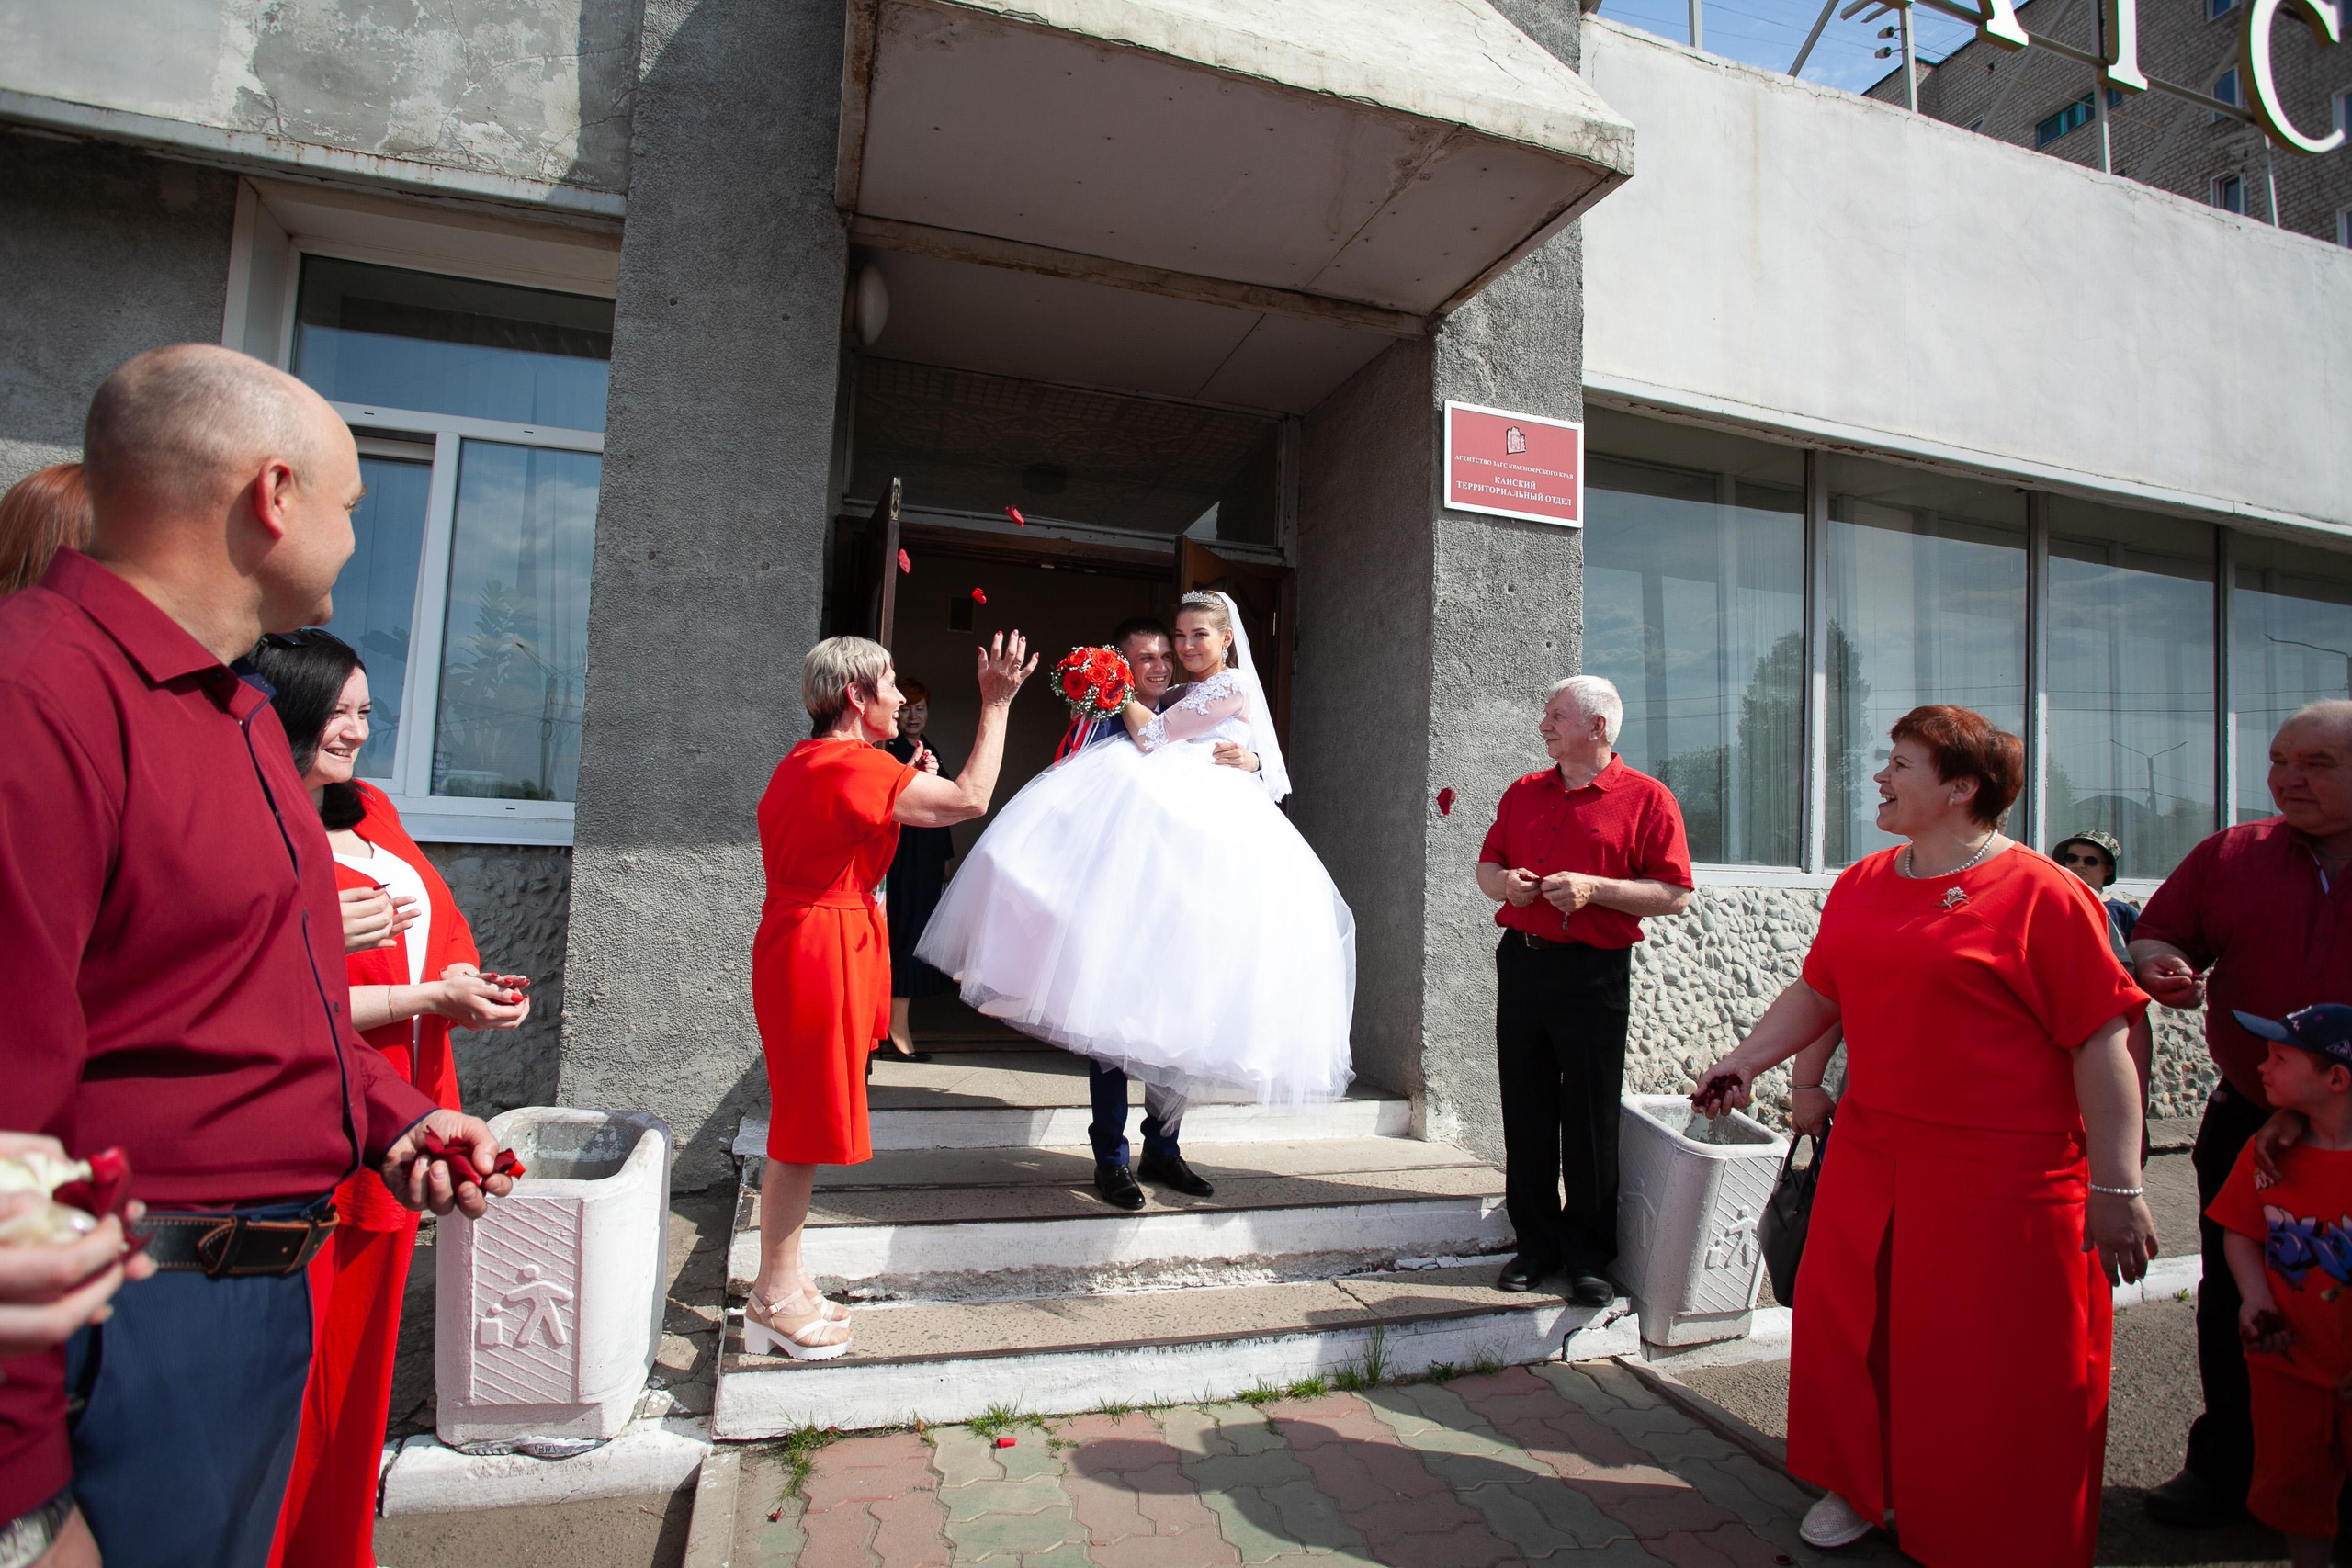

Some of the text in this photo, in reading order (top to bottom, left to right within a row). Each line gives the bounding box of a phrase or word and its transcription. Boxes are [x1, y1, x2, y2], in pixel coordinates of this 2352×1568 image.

[1455, 455, 1574, 479] АГЕНТСТВО ЗАГС КРАСНОЯРСКОГО КРАЯ
[1456, 480, 1572, 506] ТЕРРИТОРИАЛЬНЫЙ ОТДЕЛ
[1494, 476, 1536, 490] КАНСКИЙ
